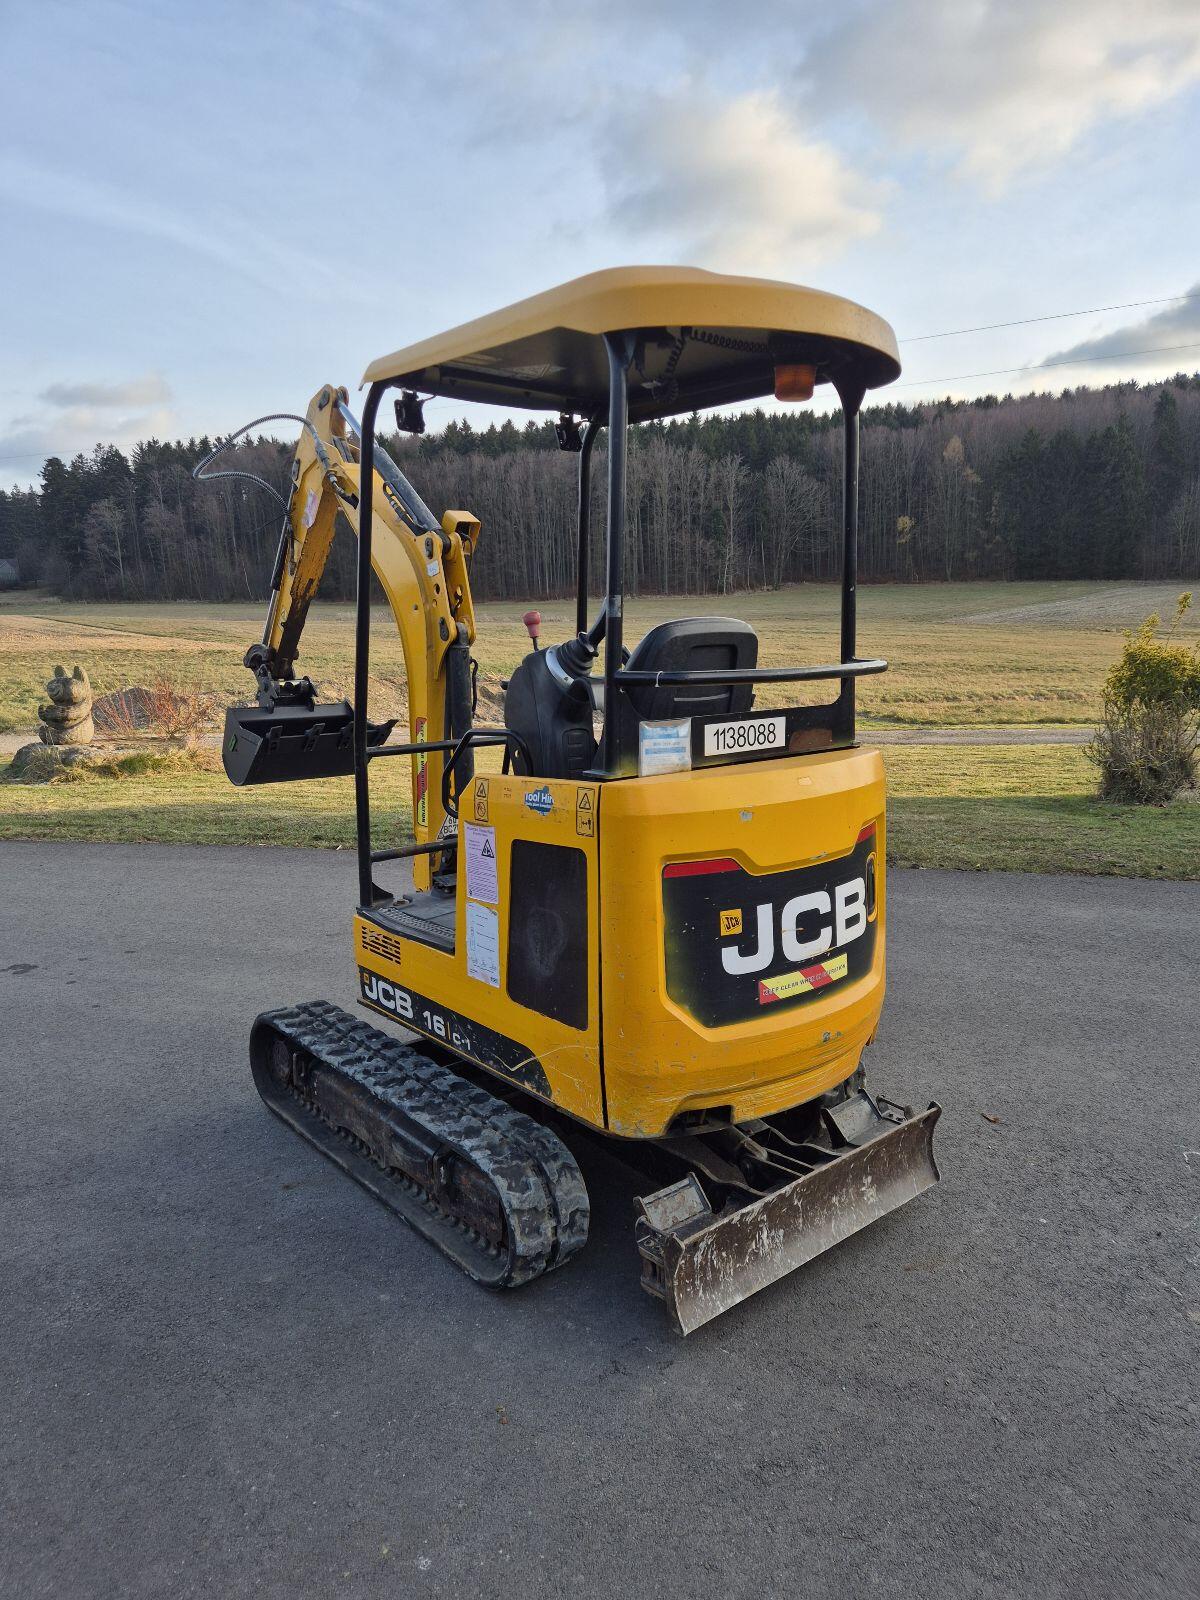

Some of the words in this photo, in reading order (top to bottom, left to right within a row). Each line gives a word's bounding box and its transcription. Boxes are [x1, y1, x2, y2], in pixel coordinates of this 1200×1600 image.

[713, 722, 776, 750] 1138088
[721, 876, 866, 976] JCB
[725, 916, 740, 930] JCB
[364, 976, 414, 1019] JCB
[422, 1010, 446, 1037] 16
